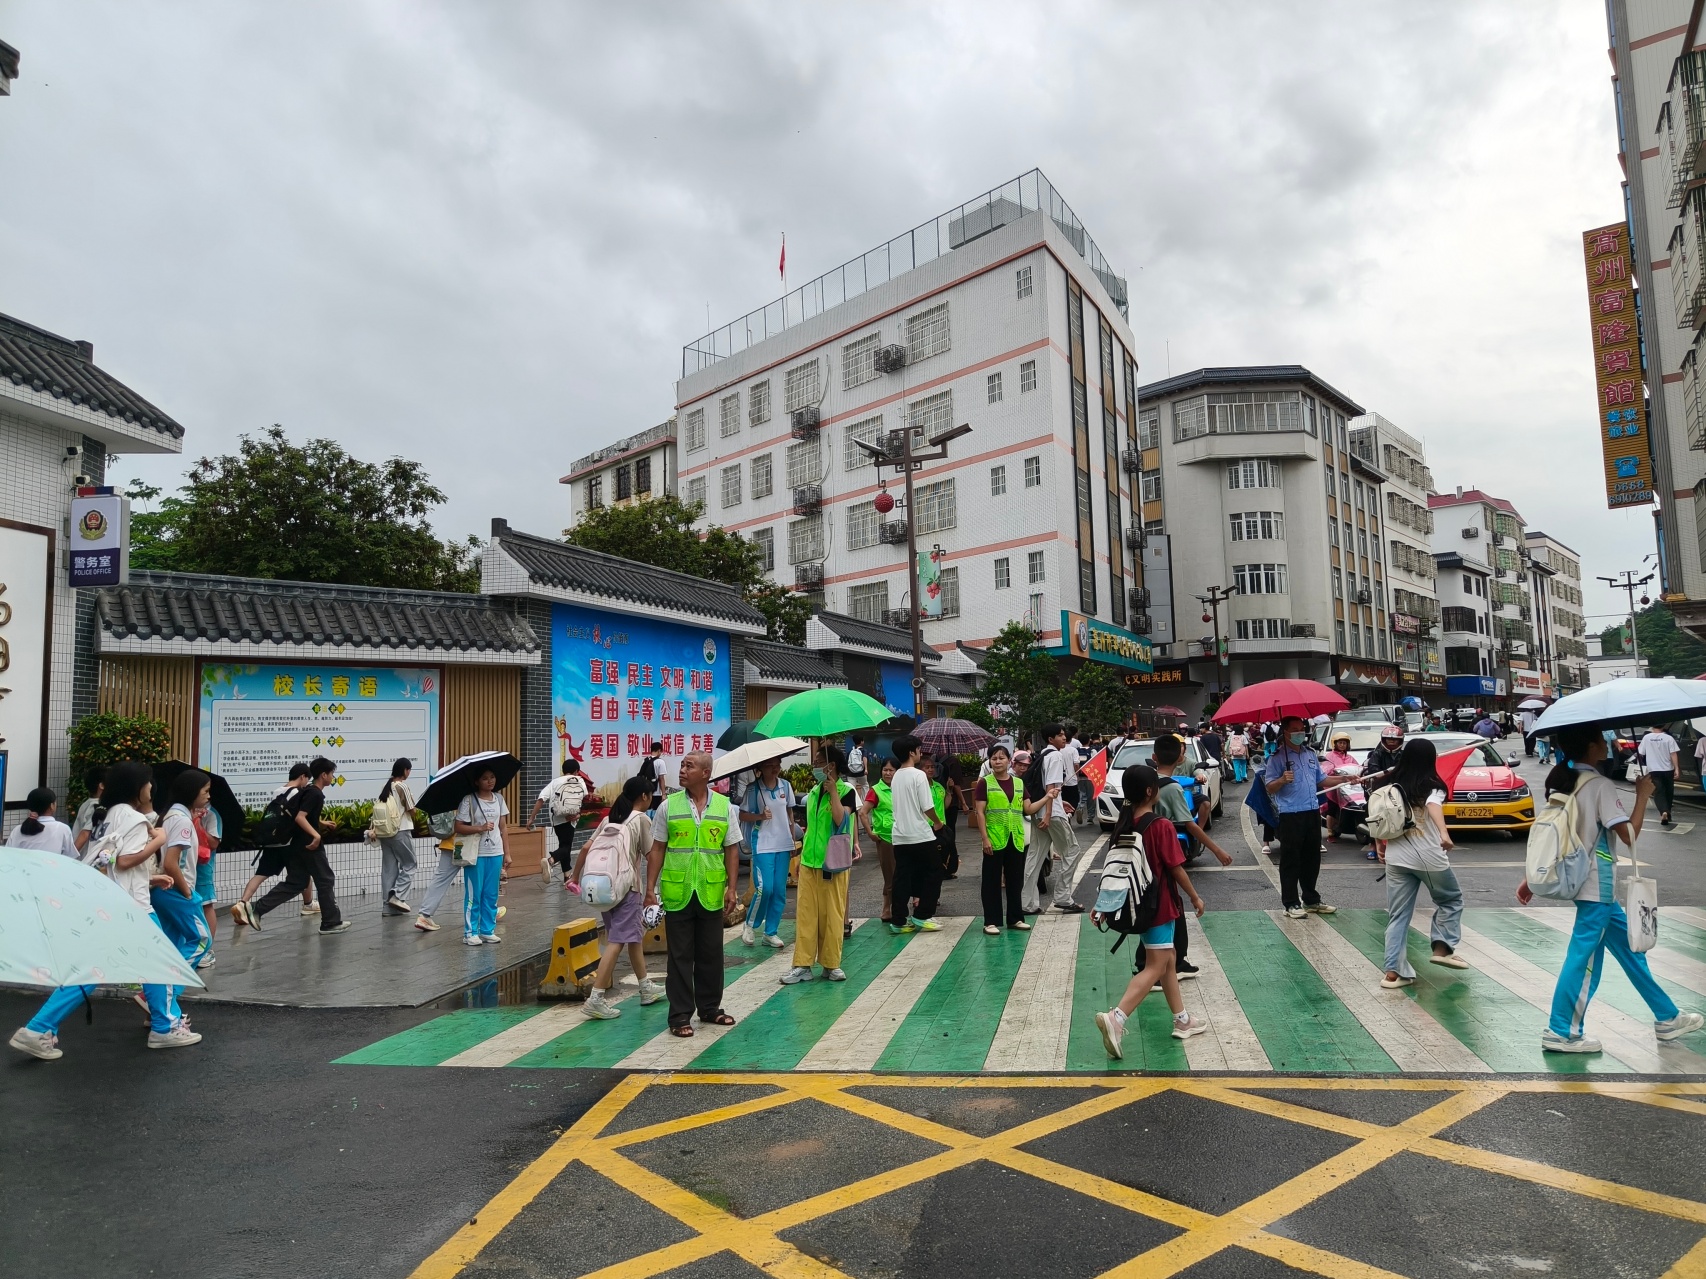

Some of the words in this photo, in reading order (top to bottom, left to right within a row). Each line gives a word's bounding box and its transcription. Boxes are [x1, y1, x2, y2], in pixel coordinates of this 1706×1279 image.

[74, 555, 111, 568] 警务室
[273, 674, 378, 697] 校长寄语
[590, 658, 619, 685] 富强
[627, 662, 653, 687] 民主
[660, 666, 684, 688] 文明
[690, 669, 714, 691] 和谐
[590, 696, 619, 721] 自由
[627, 698, 653, 721] 平等
[660, 700, 684, 722] 公正
[690, 702, 714, 722] 法治
[590, 734, 619, 758] 爱国
[627, 734, 653, 757] 敬业
[660, 734, 684, 756] 诚信
[690, 734, 714, 756] 友善
